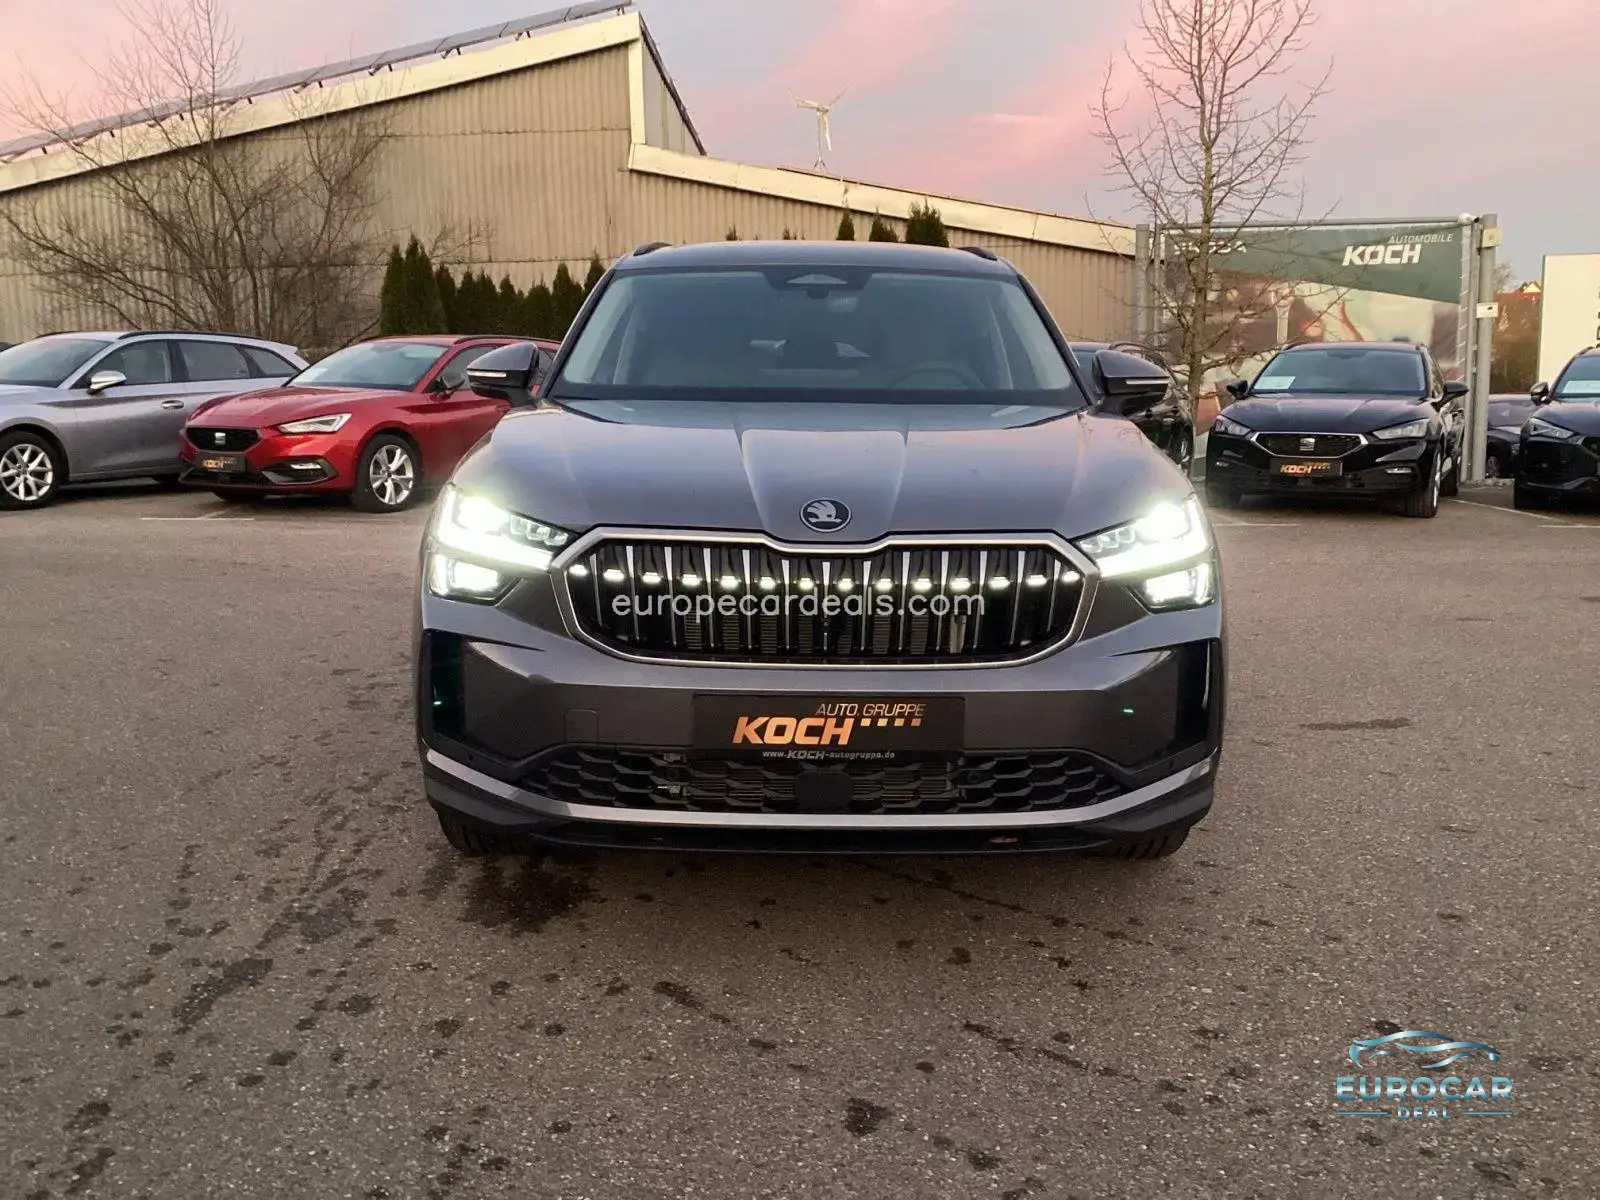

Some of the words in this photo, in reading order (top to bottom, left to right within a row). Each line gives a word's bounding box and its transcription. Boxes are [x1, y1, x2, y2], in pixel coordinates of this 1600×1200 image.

[1388, 232, 1454, 244] AUTOMOBILE
[1342, 244, 1422, 266] KOCH
[1280, 464, 1313, 474] KOCH
[862, 703, 926, 717] GRUPPE
[732, 716, 854, 745] KOCH
